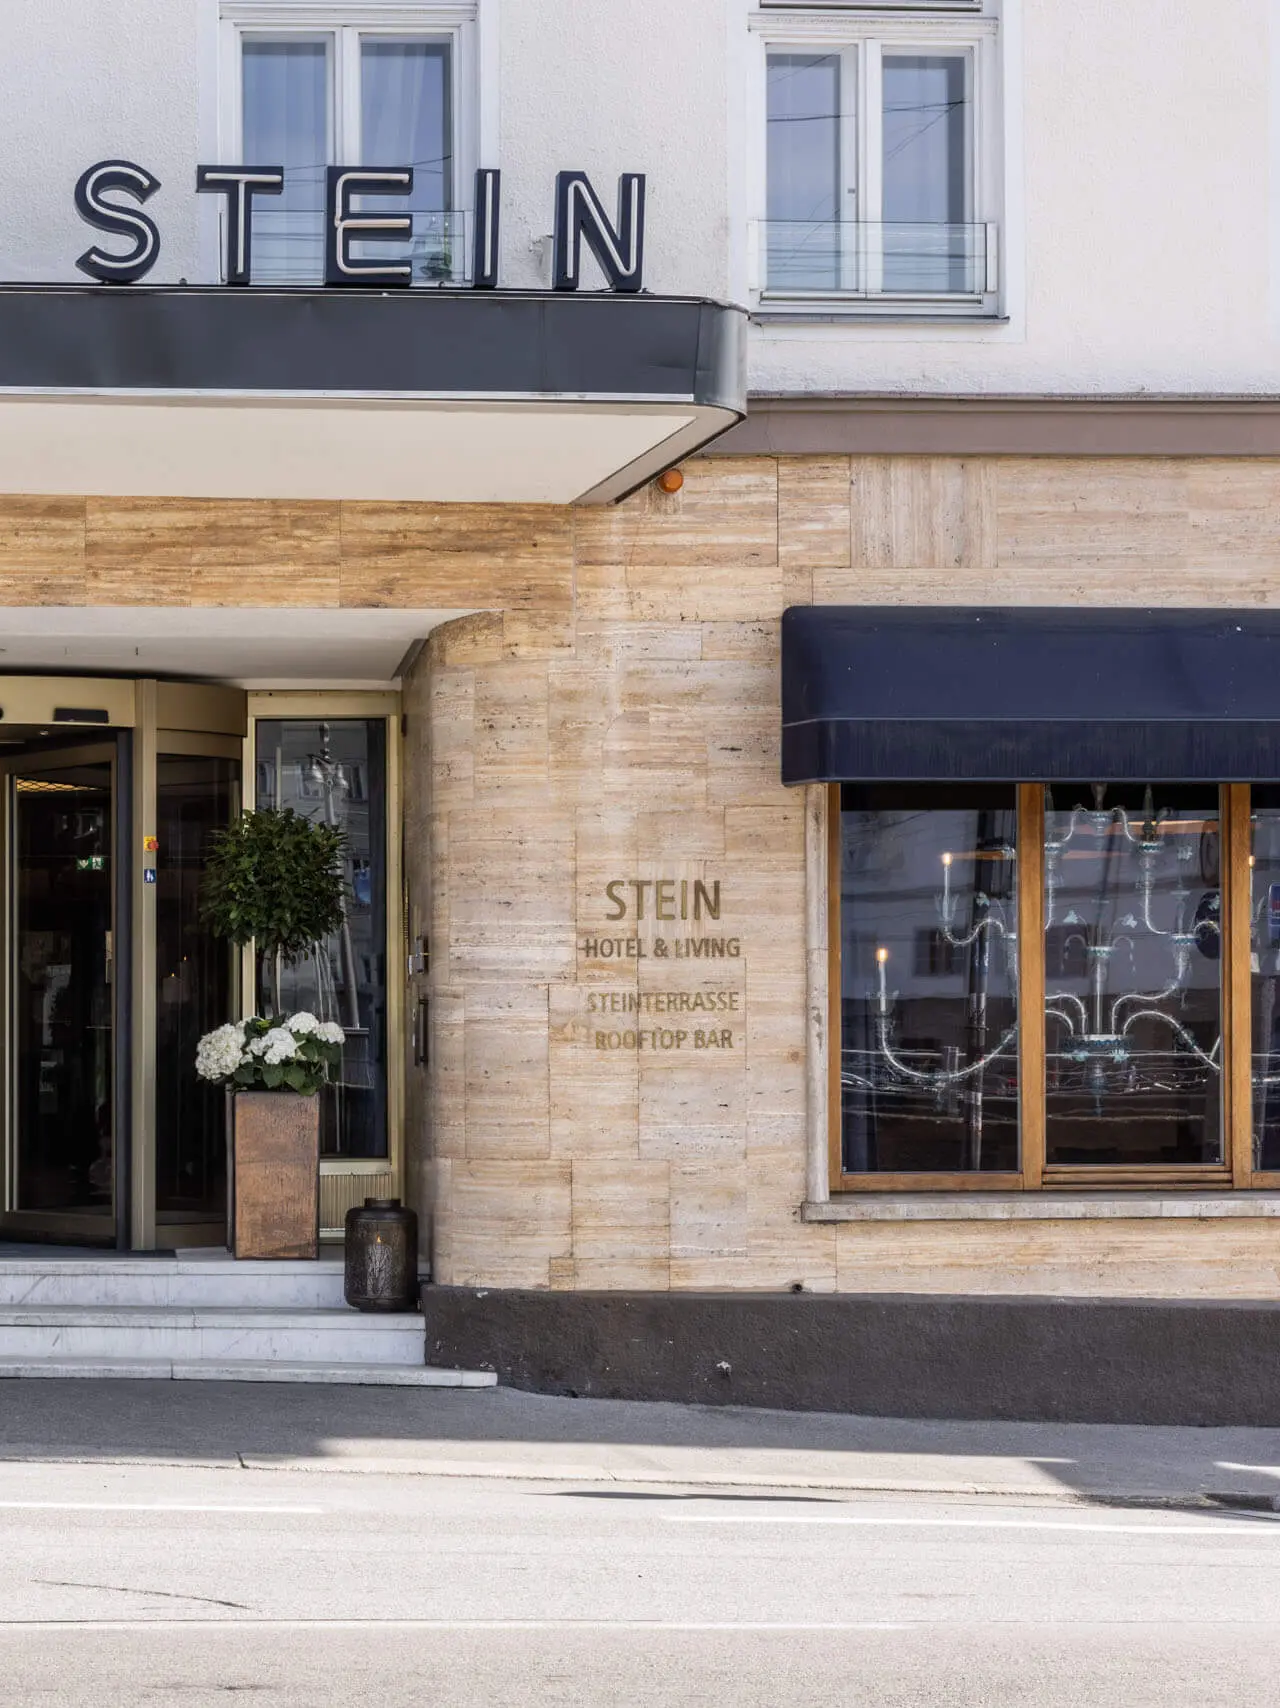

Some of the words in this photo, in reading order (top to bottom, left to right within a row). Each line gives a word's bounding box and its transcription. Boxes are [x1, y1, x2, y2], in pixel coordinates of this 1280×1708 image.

[74, 160, 646, 292] STEIN
[606, 879, 721, 921] STEIN
[585, 938, 647, 958] HOTEL
[653, 938, 669, 958] &
[675, 937, 741, 959] LIVING
[586, 991, 740, 1013] STEINTERRASSE
[595, 1029, 688, 1050] ROOFTOP
[694, 1029, 734, 1049] BAR
